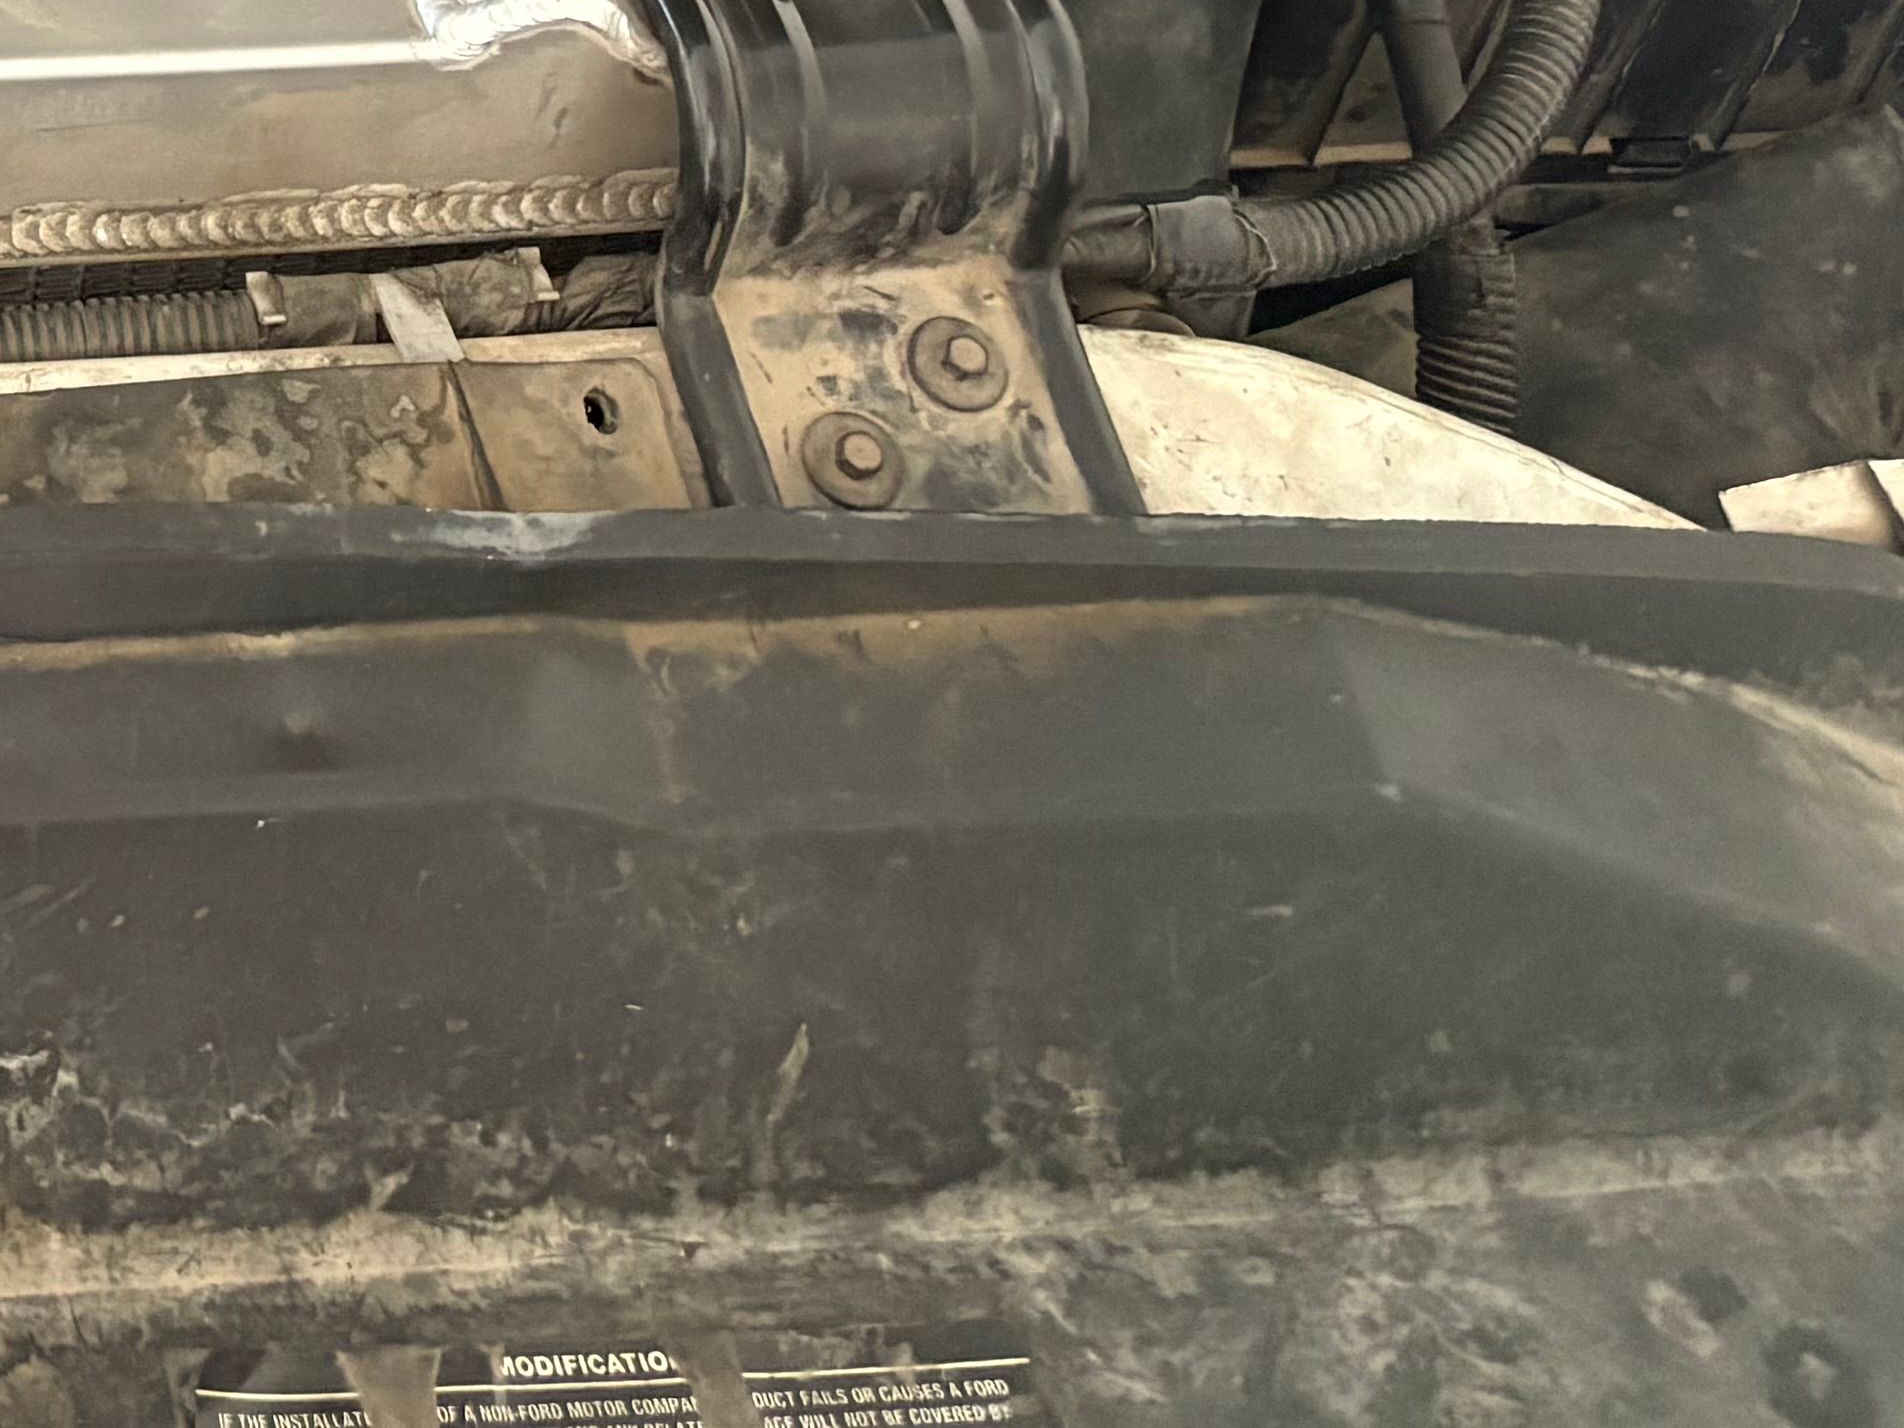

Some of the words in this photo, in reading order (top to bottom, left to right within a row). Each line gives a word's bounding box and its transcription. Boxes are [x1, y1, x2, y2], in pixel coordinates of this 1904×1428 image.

[436, 1405, 457, 1424] OF
[463, 1404, 478, 1424] A
[479, 1402, 564, 1424] NON-FORD
[567, 1399, 628, 1420] MOTOR
[799, 1388, 849, 1407] FAILS
[851, 1386, 877, 1404] OR
[878, 1382, 945, 1404] CAUSES
[948, 1381, 963, 1399] A
[964, 1379, 1010, 1398] FORD
[843, 1410, 880, 1428] NOT
[908, 1404, 987, 1425] COVERED
